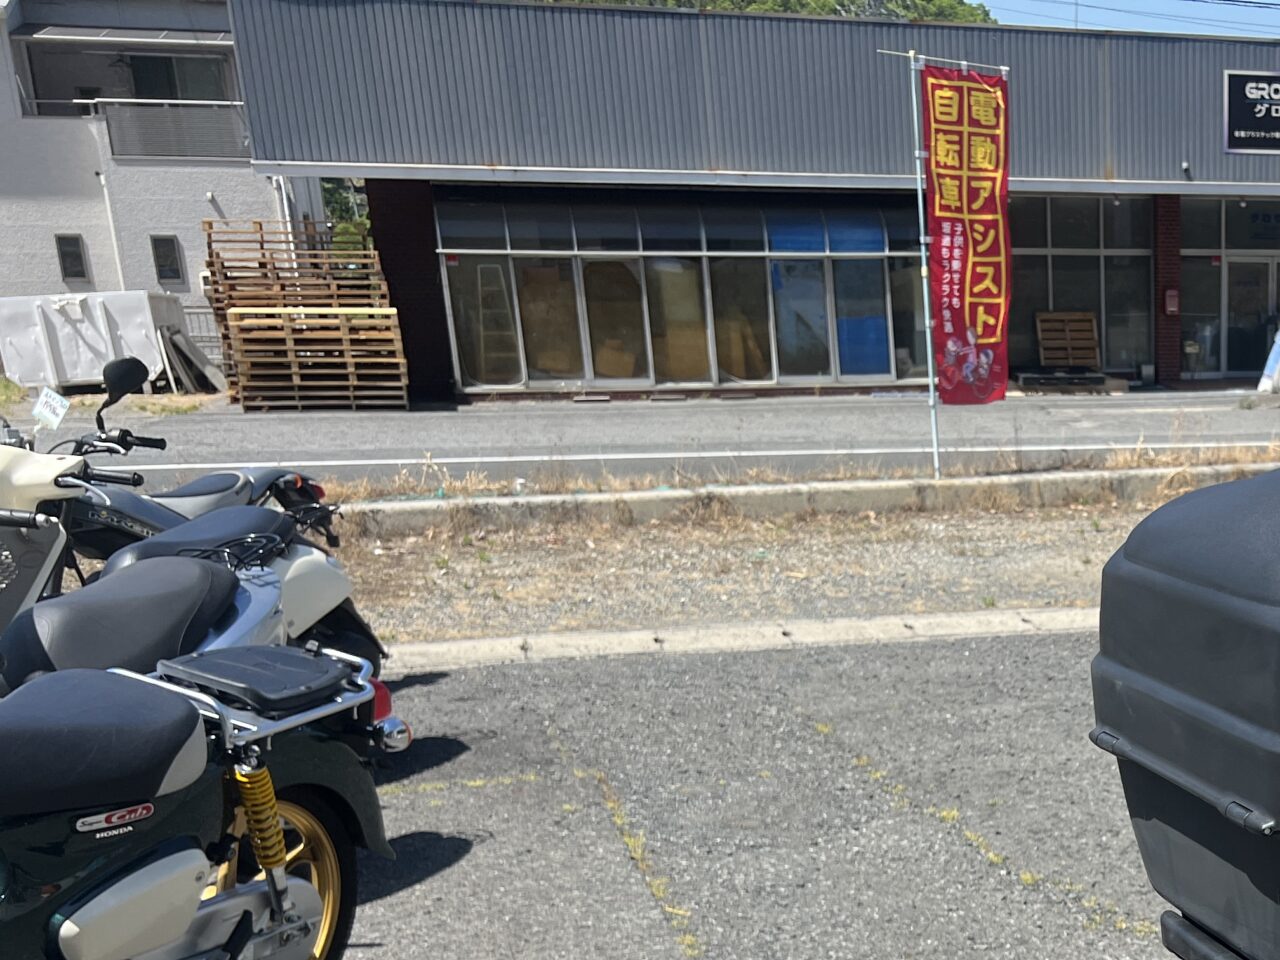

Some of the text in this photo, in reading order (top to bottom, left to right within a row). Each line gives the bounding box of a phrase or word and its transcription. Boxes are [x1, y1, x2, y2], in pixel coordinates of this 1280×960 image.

[933, 87, 962, 210] 自転車
[969, 90, 999, 335] 電動アシスト
[95, 825, 134, 839] HONDA
